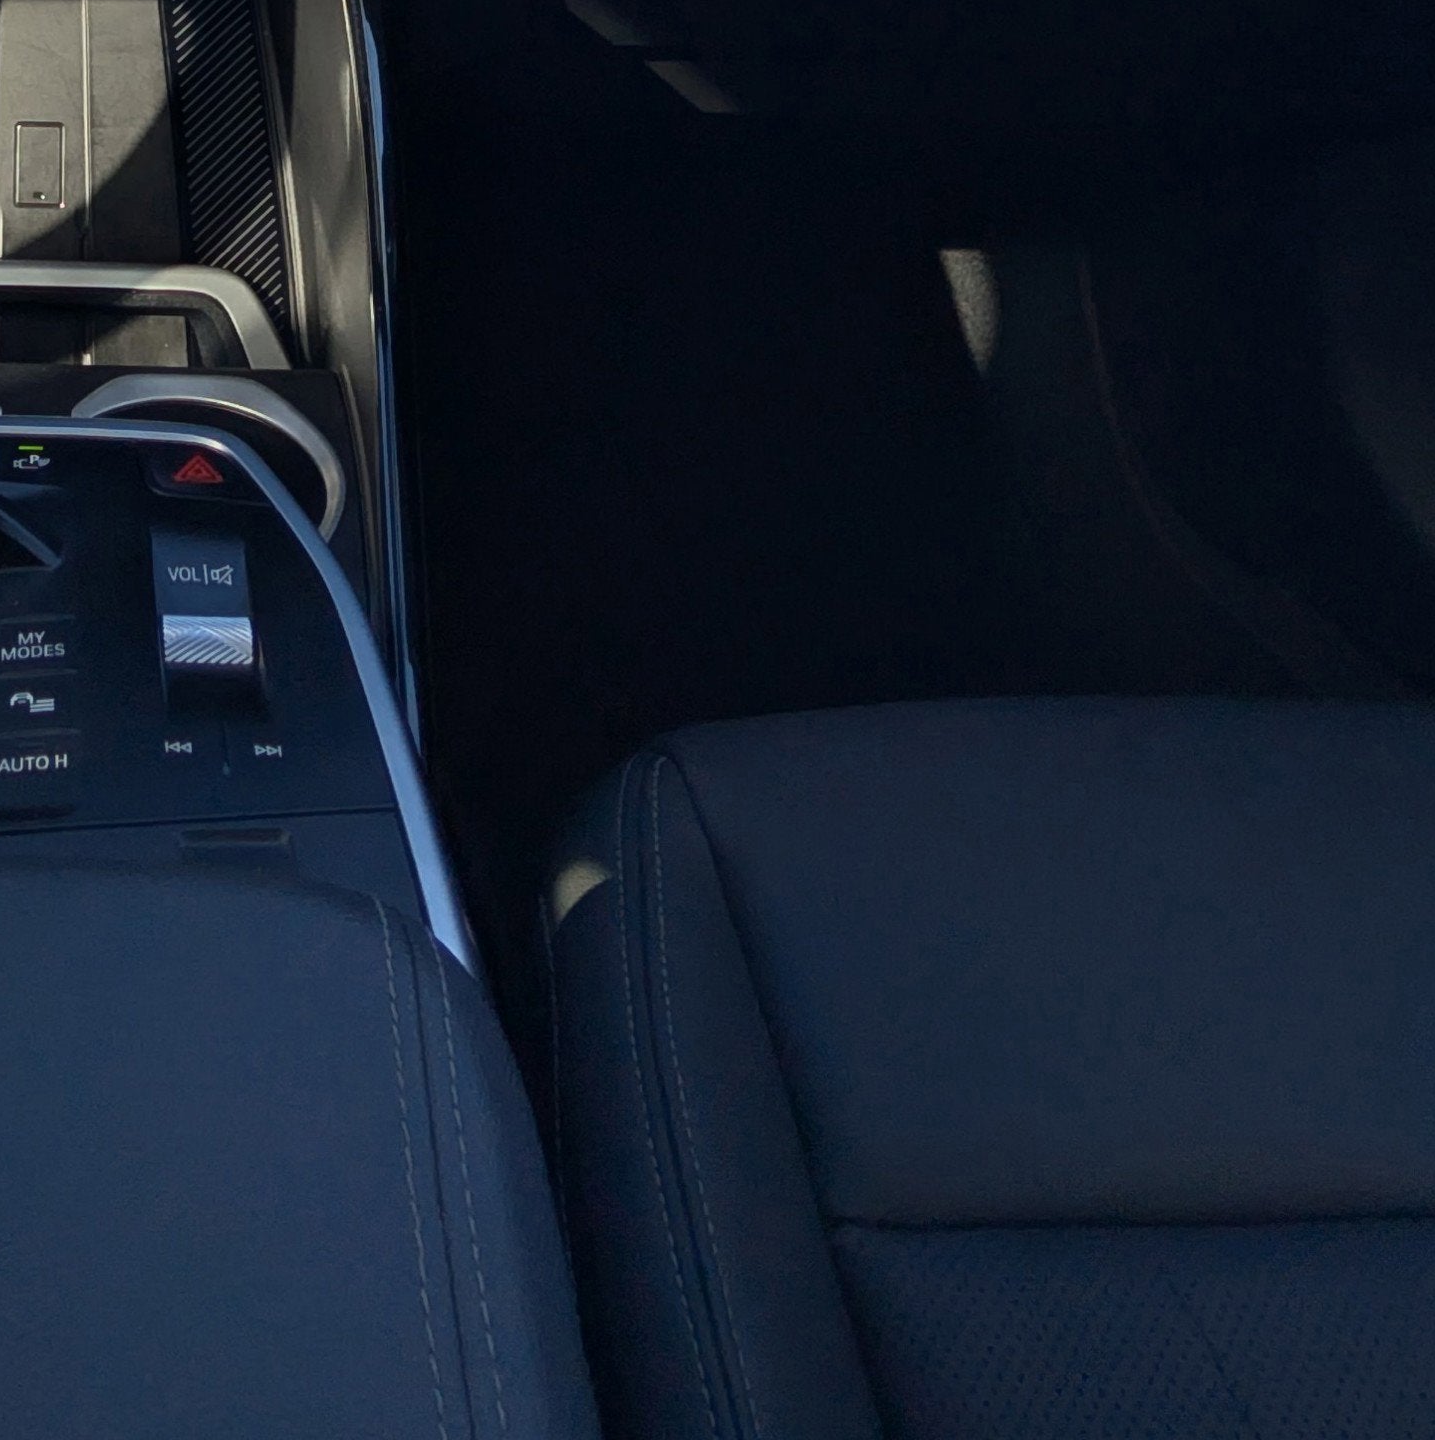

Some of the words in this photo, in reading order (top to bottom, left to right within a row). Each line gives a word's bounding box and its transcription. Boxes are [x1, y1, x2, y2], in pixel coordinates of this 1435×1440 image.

[167, 566, 201, 582] VOL
[18, 631, 46, 646] MY
[0, 643, 66, 662] MODES
[54, 754, 69, 769] H
